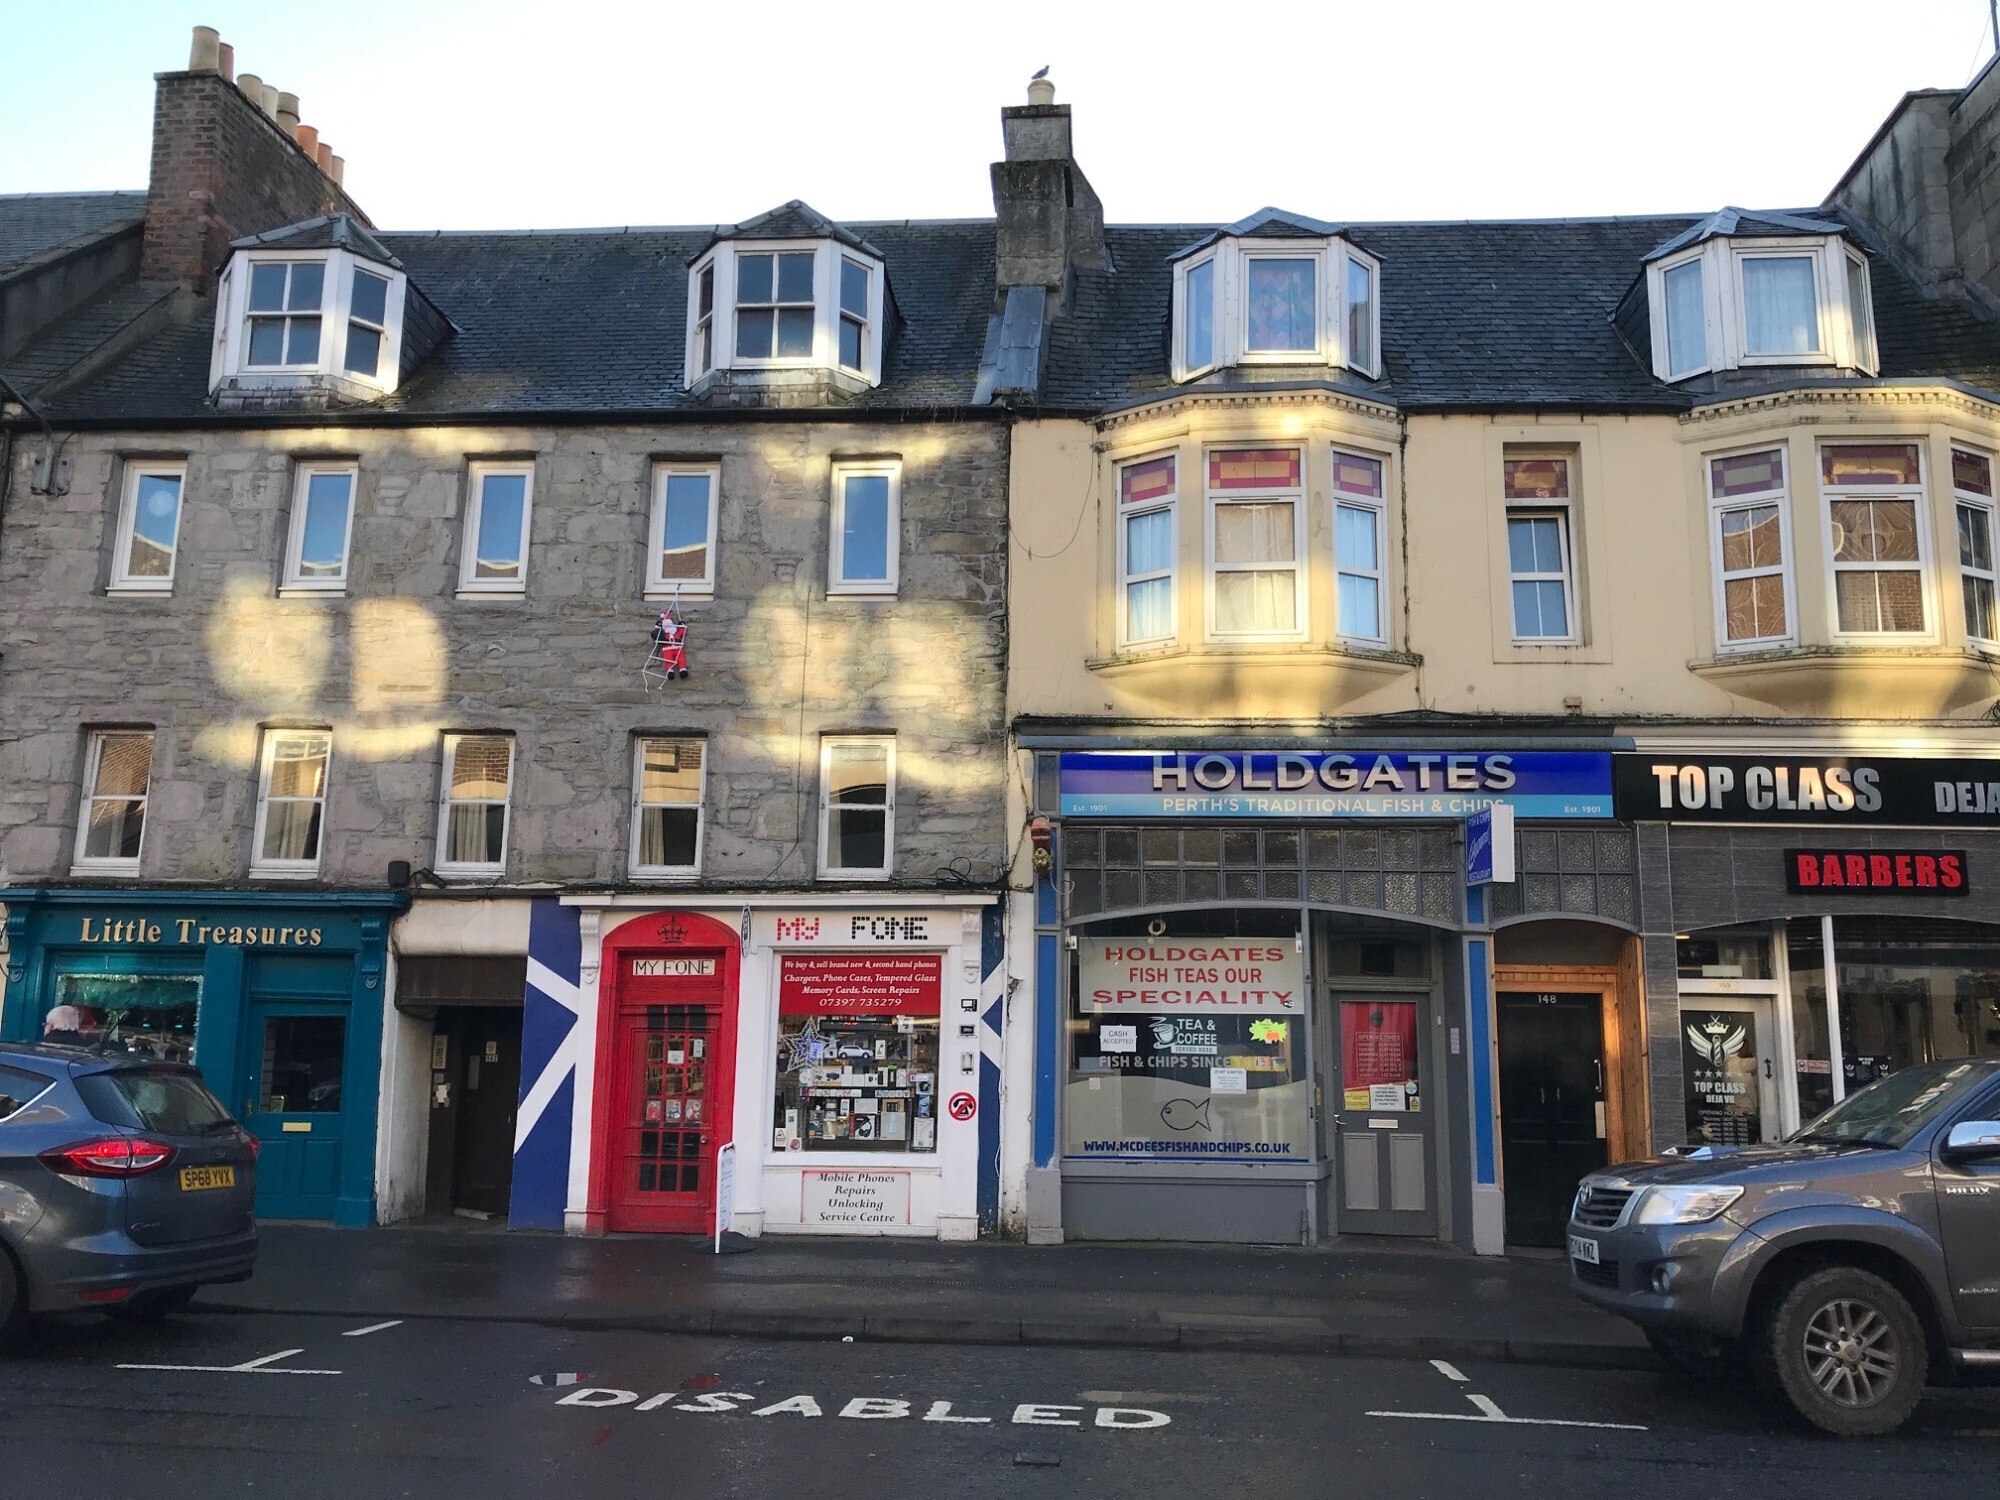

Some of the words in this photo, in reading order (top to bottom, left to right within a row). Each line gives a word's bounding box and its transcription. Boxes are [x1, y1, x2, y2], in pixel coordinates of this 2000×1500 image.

[1153, 755, 1516, 789] HOLDGATES
[1652, 765, 1734, 809] TOP
[1745, 766, 1883, 812] CLASS
[1163, 798, 1239, 812] PERTH'S
[1245, 799, 1376, 812] TRADITIONAL
[1382, 799, 1424, 813] FISH
[1430, 799, 1443, 813] &
[1797, 854, 1962, 887] BARBERS
[80, 917, 162, 944] Little
[175, 918, 323, 947] Treasures
[851, 916, 928, 940] FONE
[1105, 947, 1284, 961] HOLDGATES
[635, 960, 658, 975] MY
[663, 960, 713, 975] FONE
[795, 961, 807, 970] buy
[913, 961, 937, 970] phones
[784, 974, 821, 984] Chargers,
[823, 974, 847, 982] Phone
[849, 974, 873, 983] Cases,
[875, 974, 913, 984] Tempered
[914, 974, 937, 982] Glass
[1129, 967, 1168, 983] FISH
[1174, 968, 1218, 983] TEAS
[1224, 968, 1262, 983] OUR
[802, 986, 834, 995] Memory
[861, 986, 887, 994] Screen
[889, 986, 920, 995] Repairs
[1092, 990, 1293, 1004] SPECIALITY
[819, 999, 855, 1007] 07397
[859, 999, 902, 1007] 735279
[1538, 994, 1557, 1004] 148
[1177, 1018, 1203, 1030] TEA
[1206, 1019, 1216, 1031] &
[1177, 1033, 1217, 1045] COFFEE
[1099, 1055, 1129, 1067] FISH
[1134, 1056, 1144, 1067] &
[1147, 1056, 1188, 1068] CHIPS
[1191, 1056, 1231, 1068] SINCE
[1693, 1081, 1713, 1093] TOP
[1714, 1082, 1746, 1094] CLASS
[1084, 1141, 1290, 1154] WWW.MCDEESFISHANDCHIPS.CO.UK
[184, 1170, 212, 1187] SP68
[212, 1169, 231, 1185] YVX
[818, 1173, 854, 1182] Mobile
[857, 1173, 895, 1183] Phones
[835, 1185, 876, 1197] Repairs
[828, 1198, 884, 1211] Unlocking
[819, 1212, 857, 1222] Service
[860, 1212, 896, 1222] Centre
[554, 1387, 1172, 1430] DISABLED
